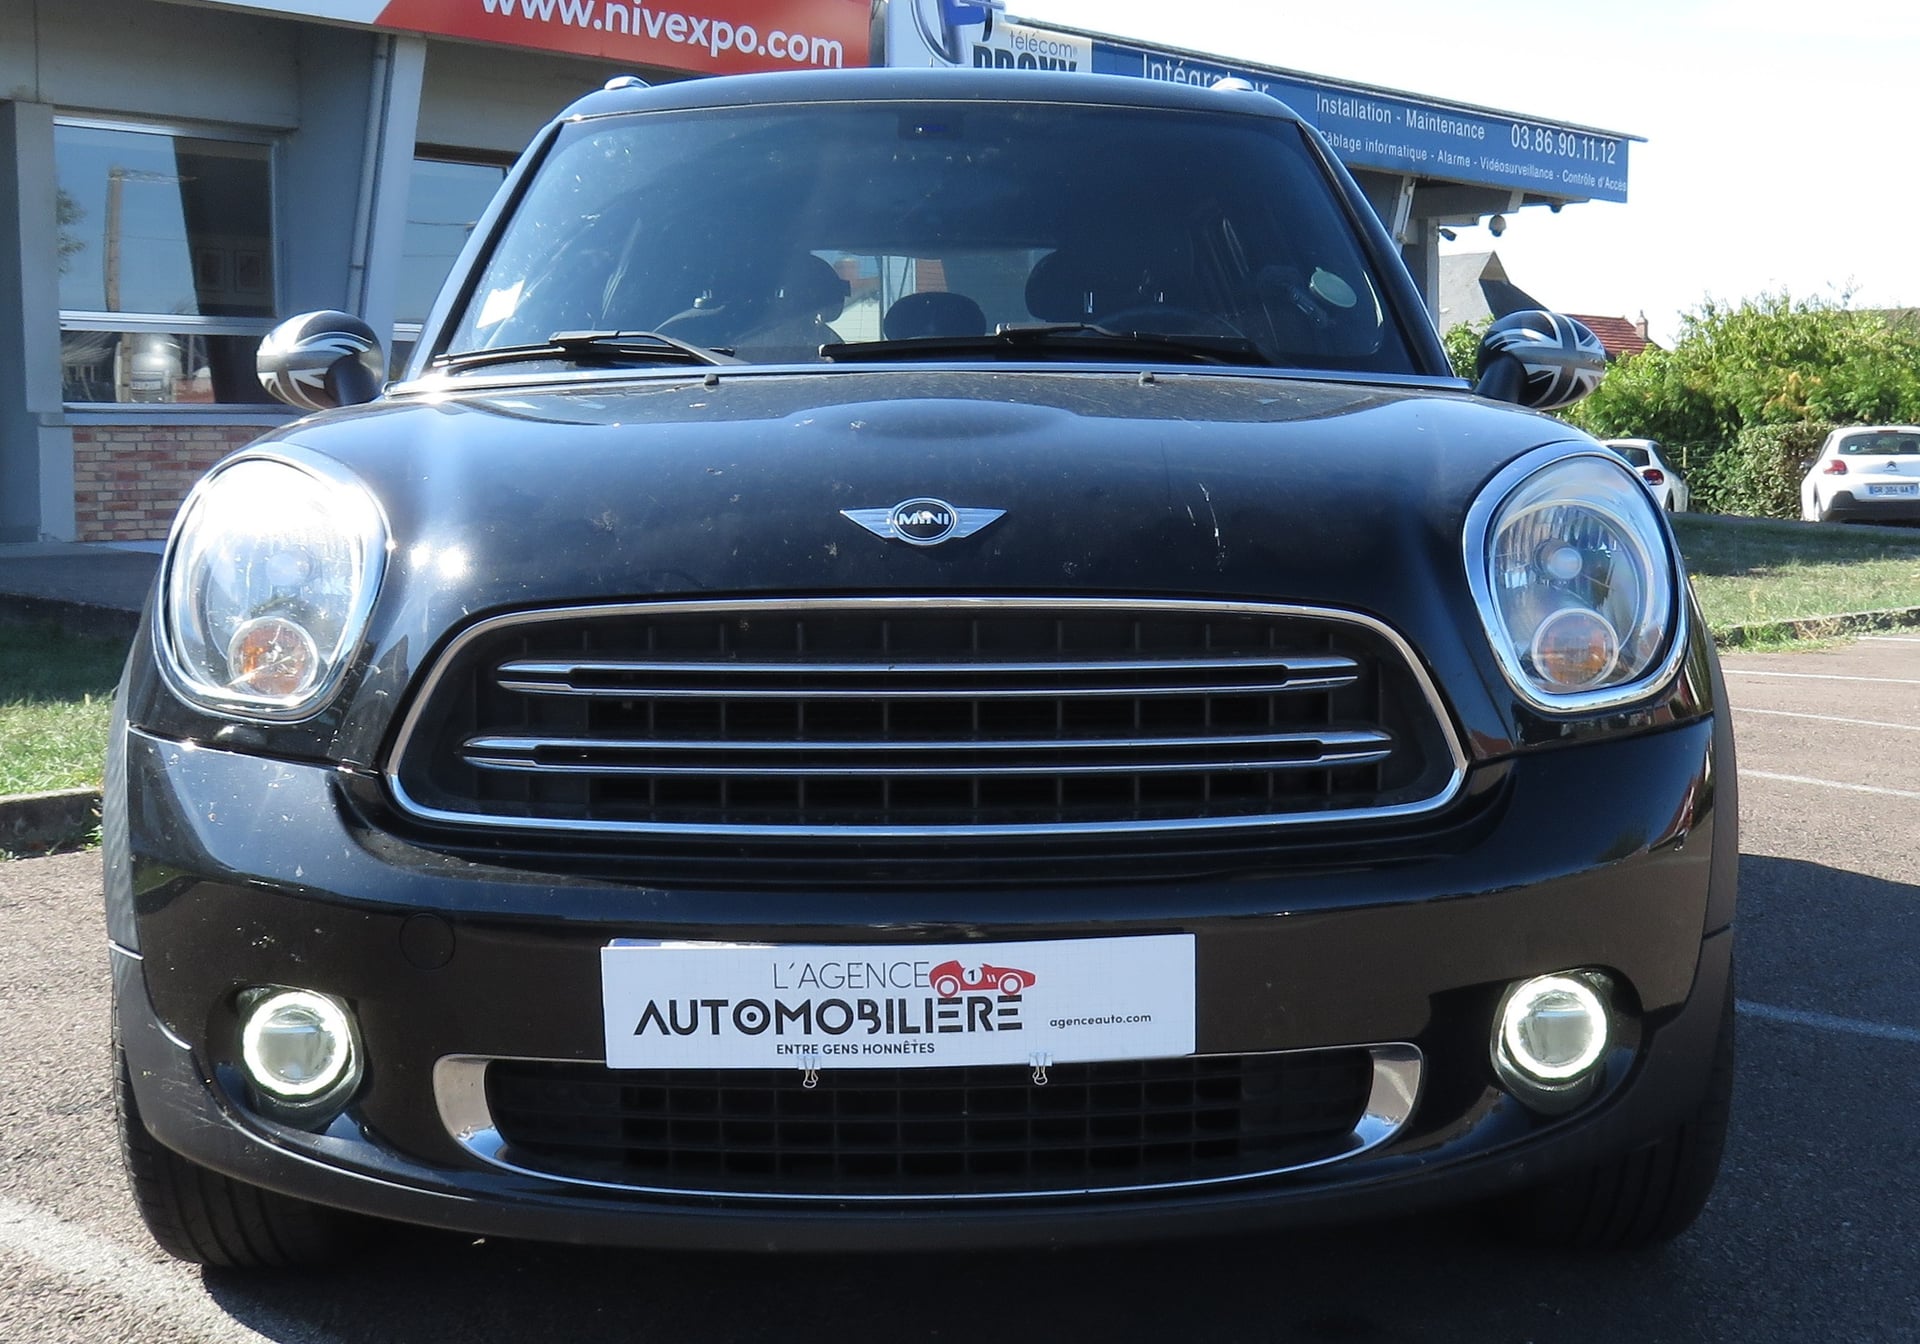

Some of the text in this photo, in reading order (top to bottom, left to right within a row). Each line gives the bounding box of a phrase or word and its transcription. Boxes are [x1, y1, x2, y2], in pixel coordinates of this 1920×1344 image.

[482, 0, 843, 68] www.nivexpo.com
[1316, 93, 1392, 124] Installation
[1406, 109, 1486, 141] Maintenance
[1511, 123, 1616, 165] 03.86.90.11.12
[1365, 138, 1428, 162] informatique
[1437, 149, 1471, 168] Alarme
[1480, 156, 1554, 181] Vidéosurveillance
[1562, 169, 1596, 188] Contrôle
[1597, 176, 1627, 192] d'Accès
[899, 511, 950, 525] MINI
[773, 962, 930, 989] L'AGENCE
[1049, 1013, 1152, 1029] agenceauto.com
[776, 1038, 935, 1055] ENTRE GENS HONNÊTES
